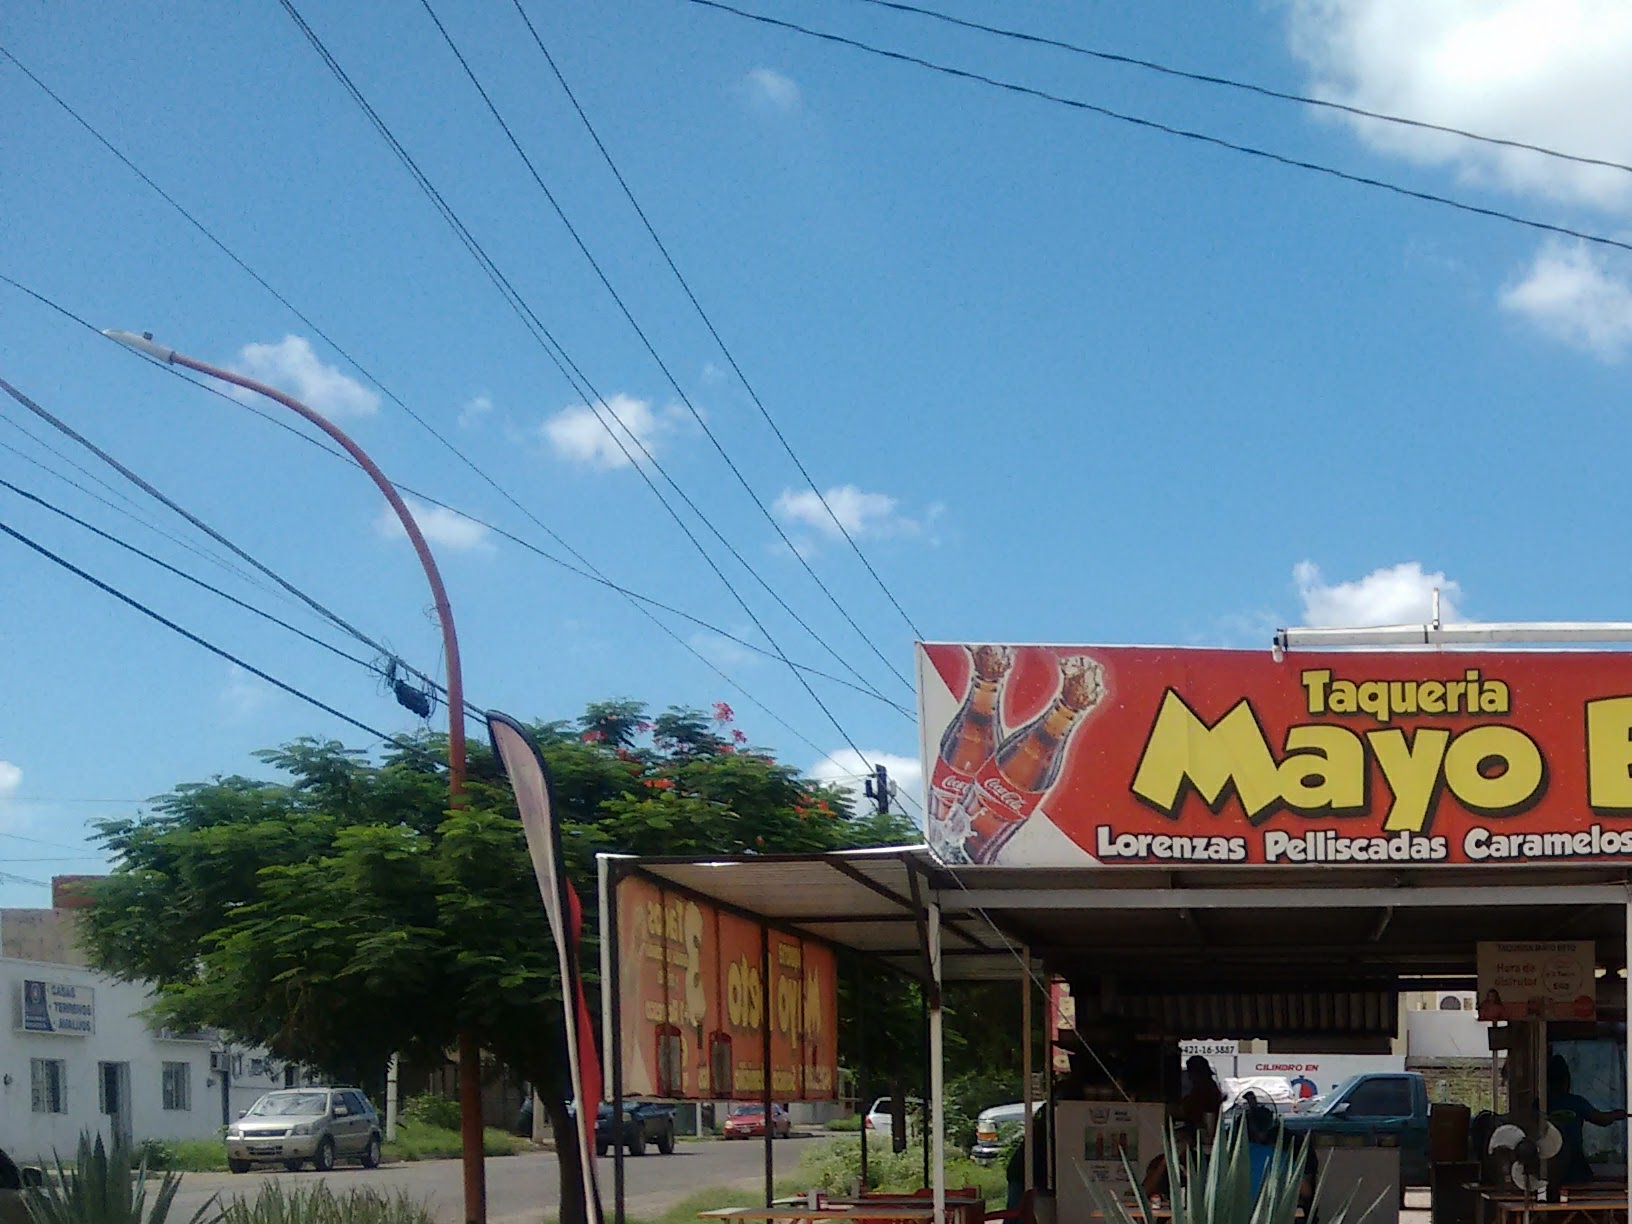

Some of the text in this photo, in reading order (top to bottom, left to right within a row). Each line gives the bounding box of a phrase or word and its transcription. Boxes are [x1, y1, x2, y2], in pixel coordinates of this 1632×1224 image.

[1301, 669, 1509, 722] Taqueria
[1131, 686, 1545, 834] Mayo
[1096, 825, 1246, 861] Lorenzas
[1263, 829, 1447, 863] Pelliscadas
[1255, 1063, 1320, 1073] CILINDRO EN
